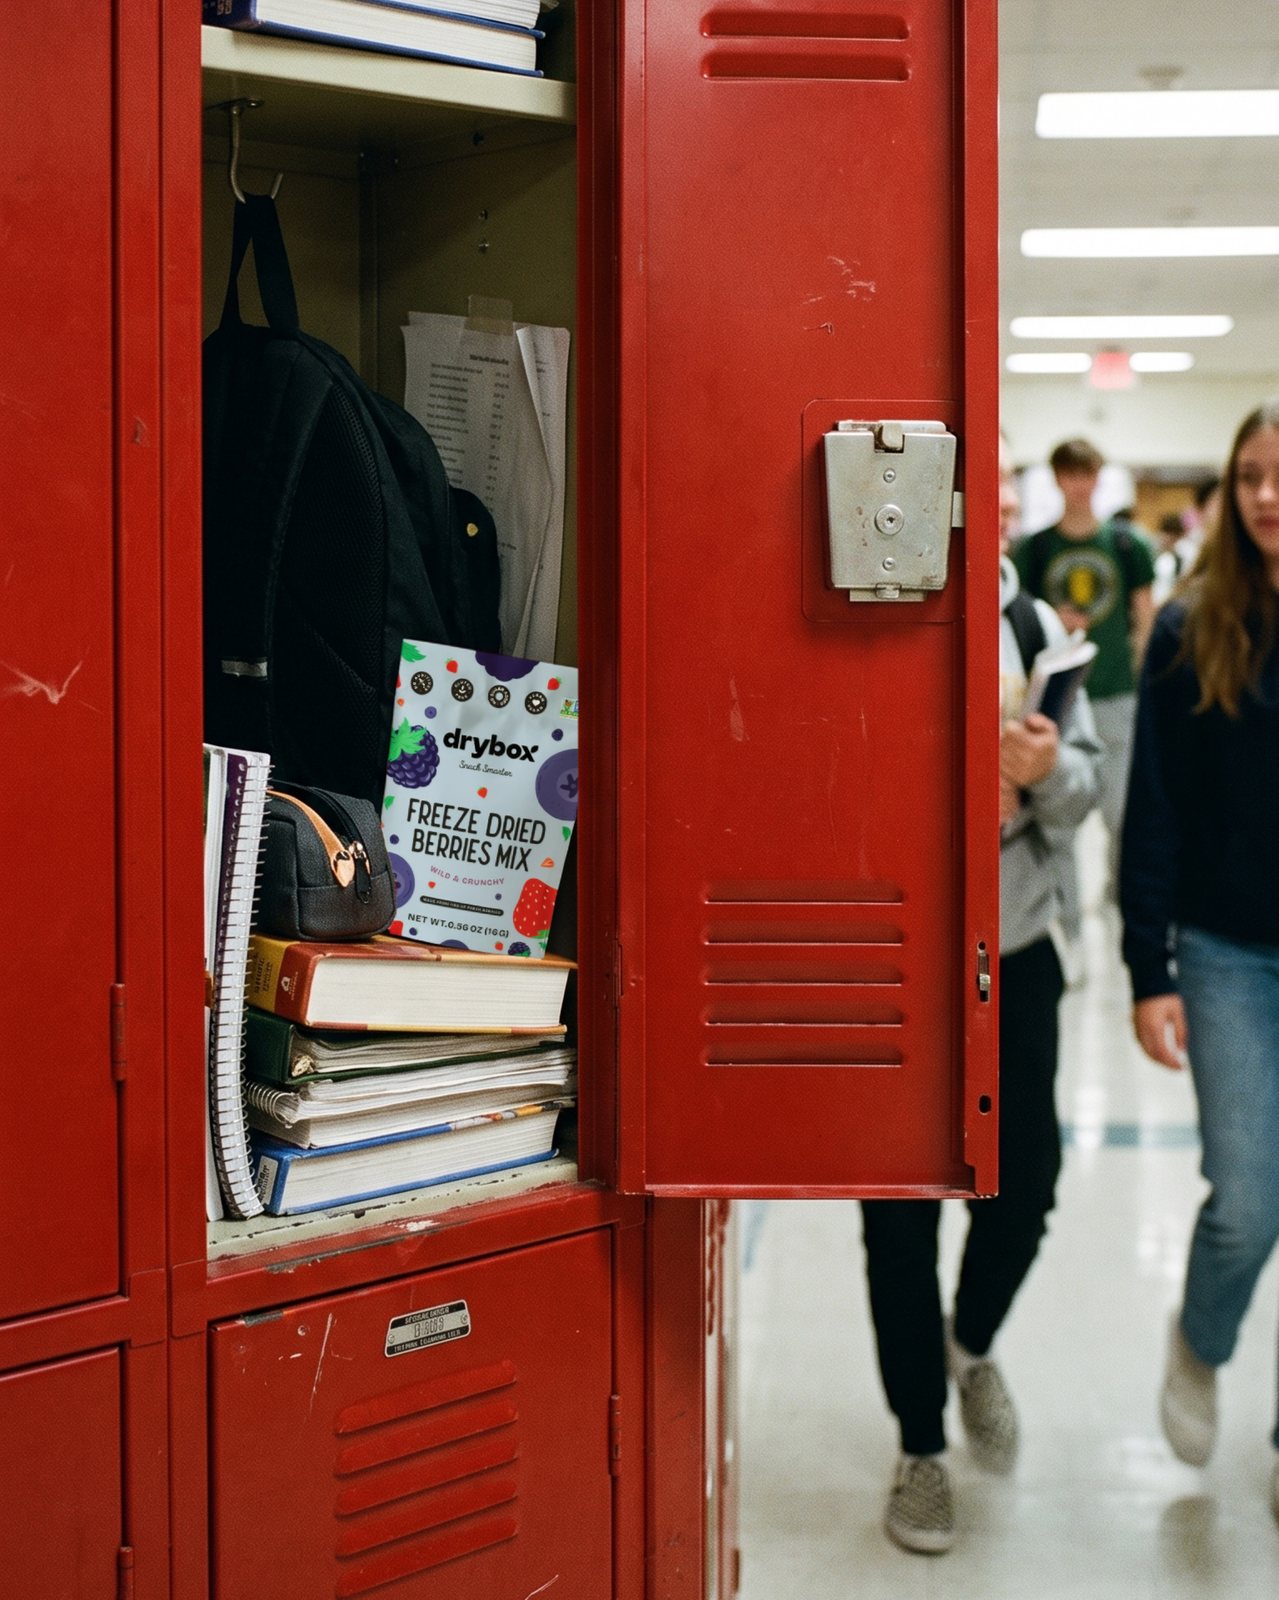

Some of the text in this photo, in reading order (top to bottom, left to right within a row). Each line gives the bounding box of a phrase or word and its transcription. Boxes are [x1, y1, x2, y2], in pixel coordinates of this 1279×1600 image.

[443, 728, 539, 762] drybox
[458, 760, 513, 777] Snack Smarter
[407, 798, 546, 845] FREEZE DRIED
[411, 828, 533, 872] BERRIES MIX
[430, 865, 451, 880] WILD
[462, 878, 505, 887] CRUNCHY
[407, 912, 428, 923] NET
[470, 924, 483, 934] OZ
